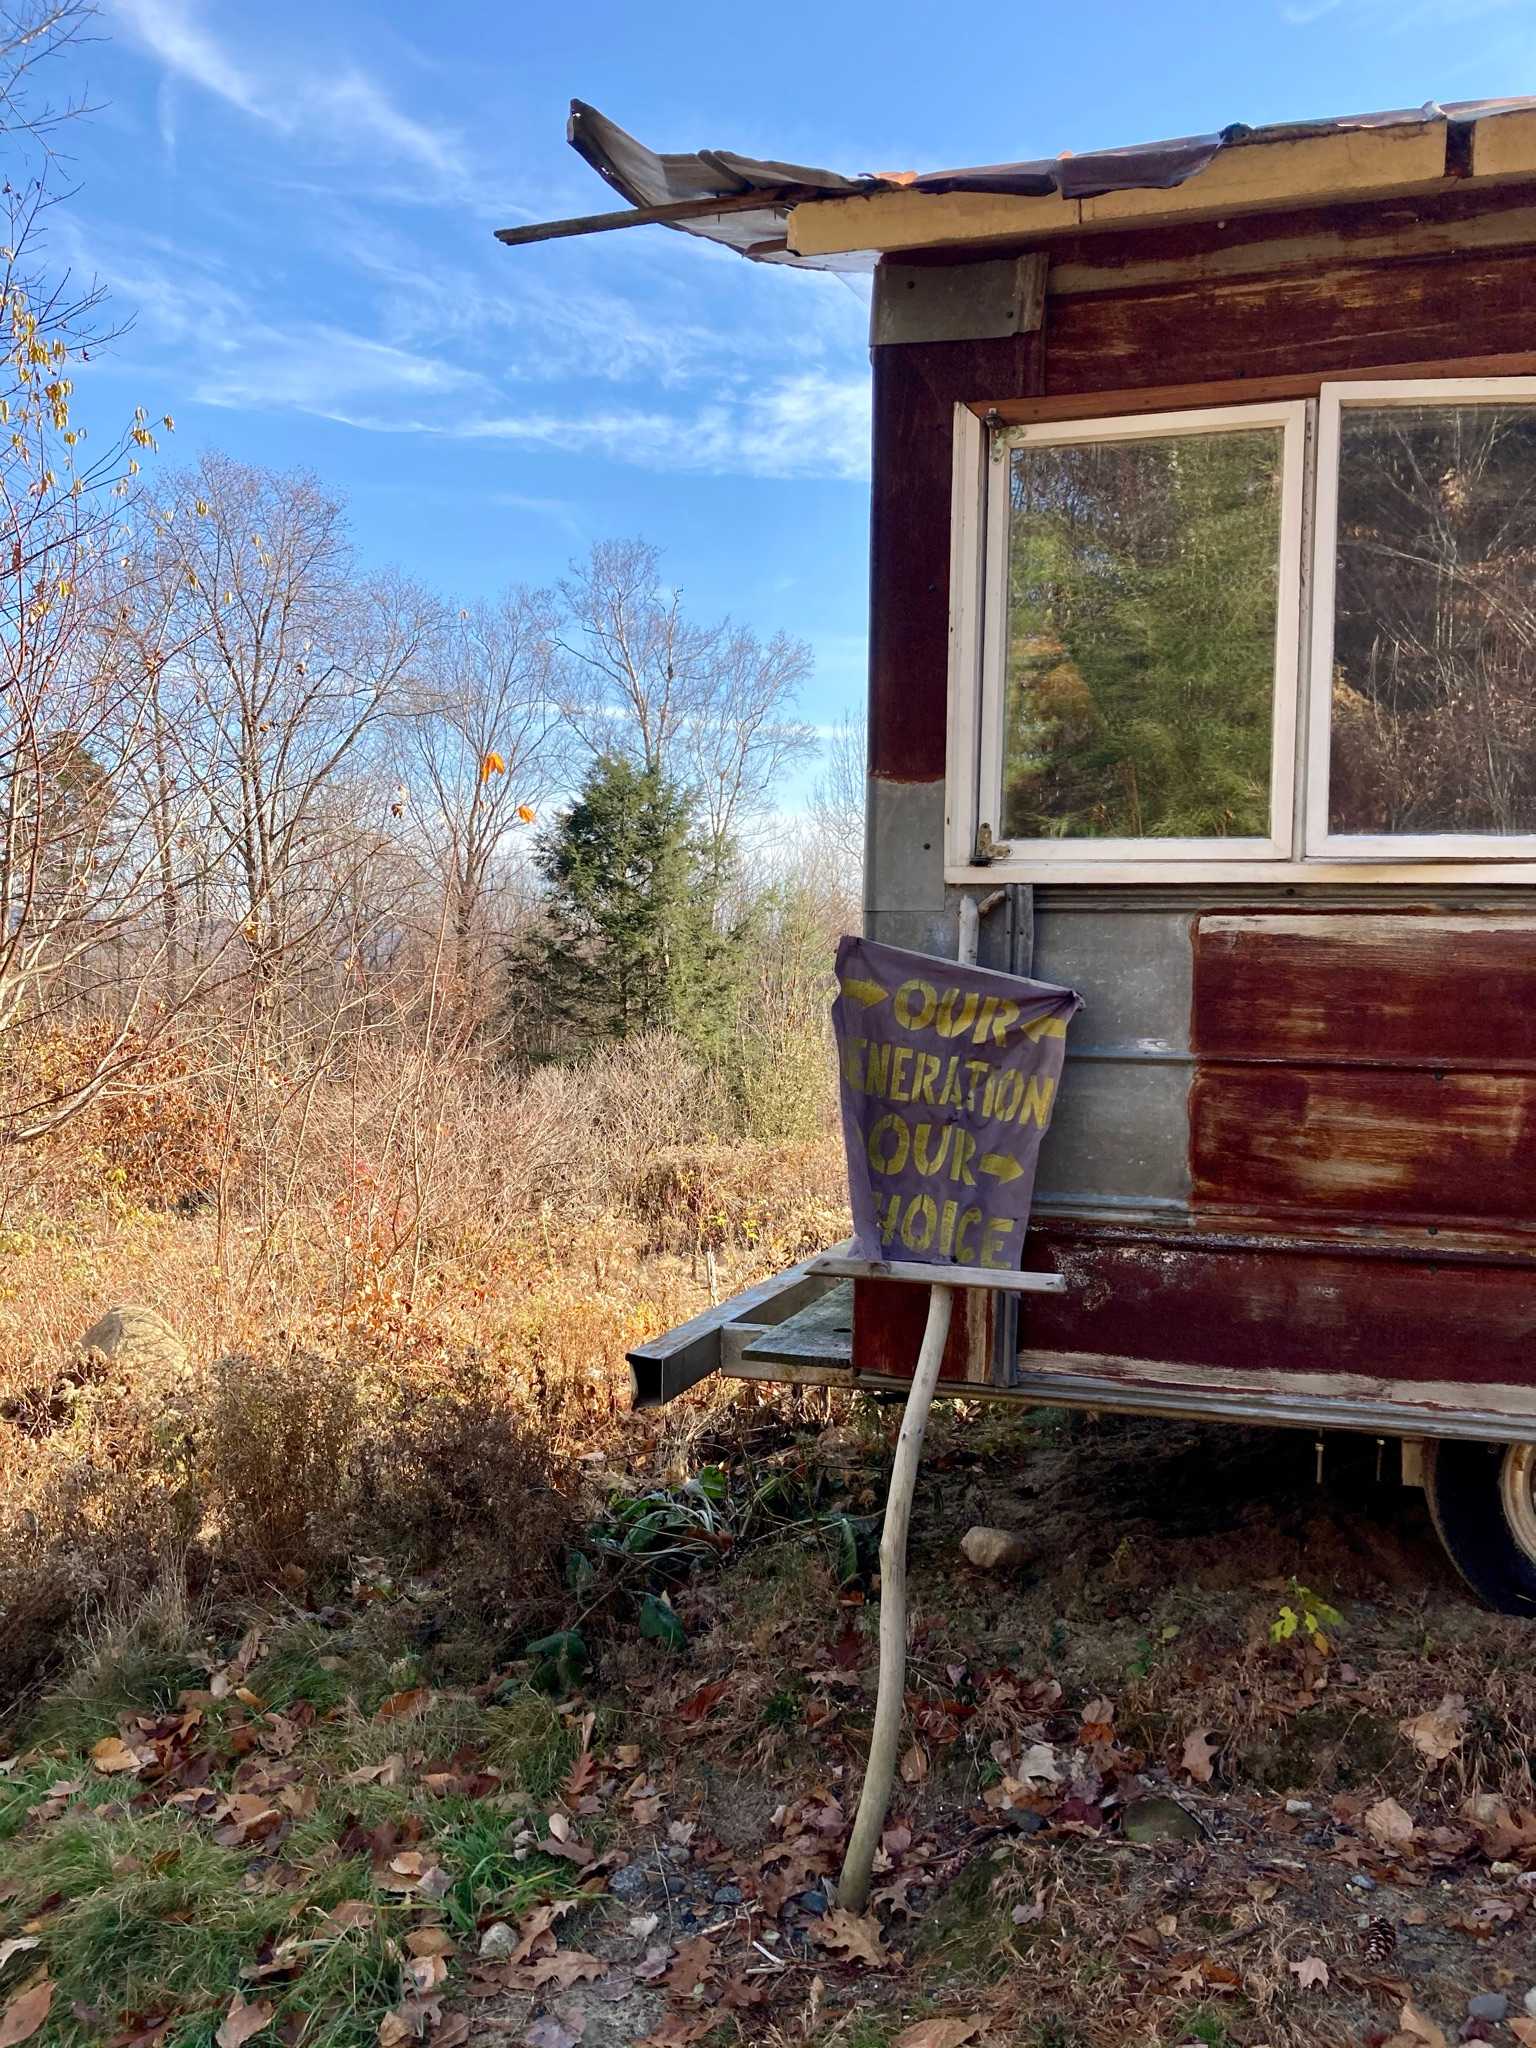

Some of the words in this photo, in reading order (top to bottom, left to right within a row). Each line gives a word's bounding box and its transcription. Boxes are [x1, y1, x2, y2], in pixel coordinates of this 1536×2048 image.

[894, 979, 1021, 1047] OUR
[846, 1038, 1055, 1130] ENERATION
[868, 1113, 977, 1186] OUR
